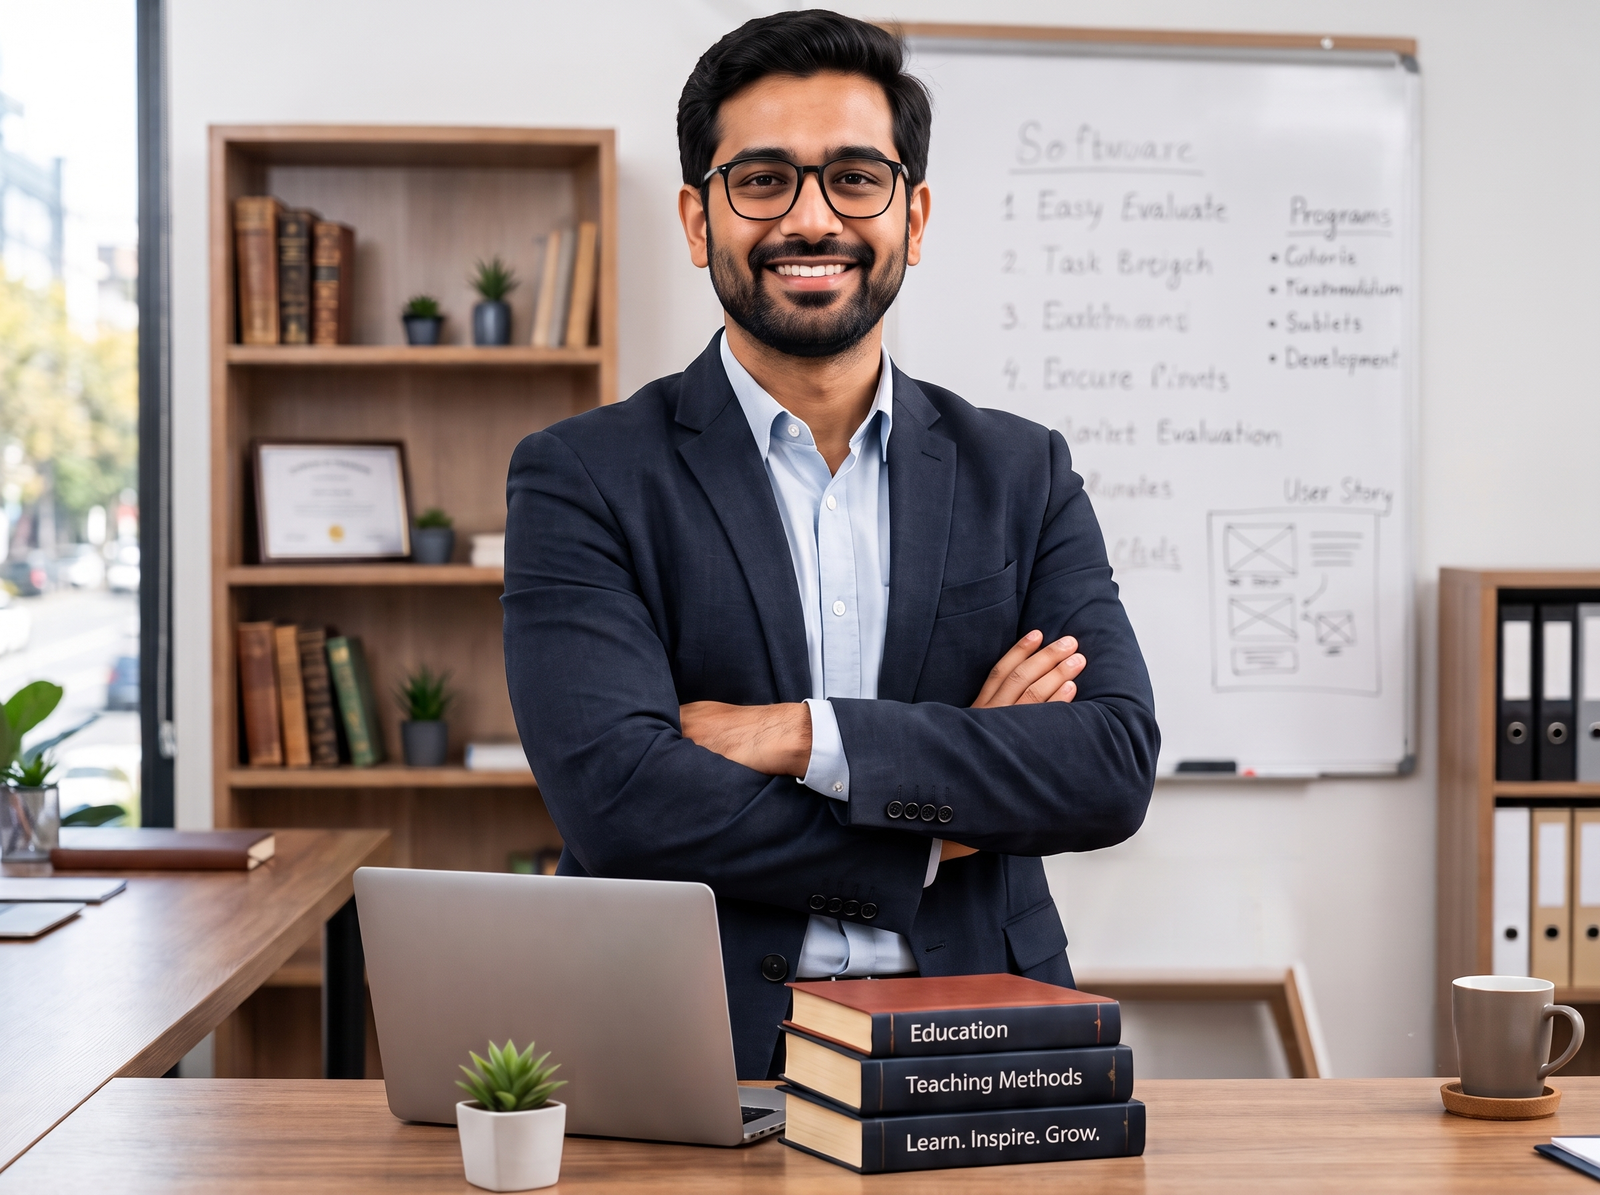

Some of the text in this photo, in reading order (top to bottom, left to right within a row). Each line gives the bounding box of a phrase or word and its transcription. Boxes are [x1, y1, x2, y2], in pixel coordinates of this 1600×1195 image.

[1015, 119, 1196, 165] Software
[1037, 190, 1103, 231] Easy
[1121, 191, 1228, 222] Evaluate
[1290, 195, 1391, 241] Programs
[1042, 246, 1100, 275] Task
[1156, 418, 1281, 447] Evaluation
[1283, 476, 1329, 503] User
[910, 1020, 1008, 1043] Education
[905, 1067, 1083, 1095] Teaching Methods
[906, 1124, 1100, 1152] Learn. Inspire. Grow.
